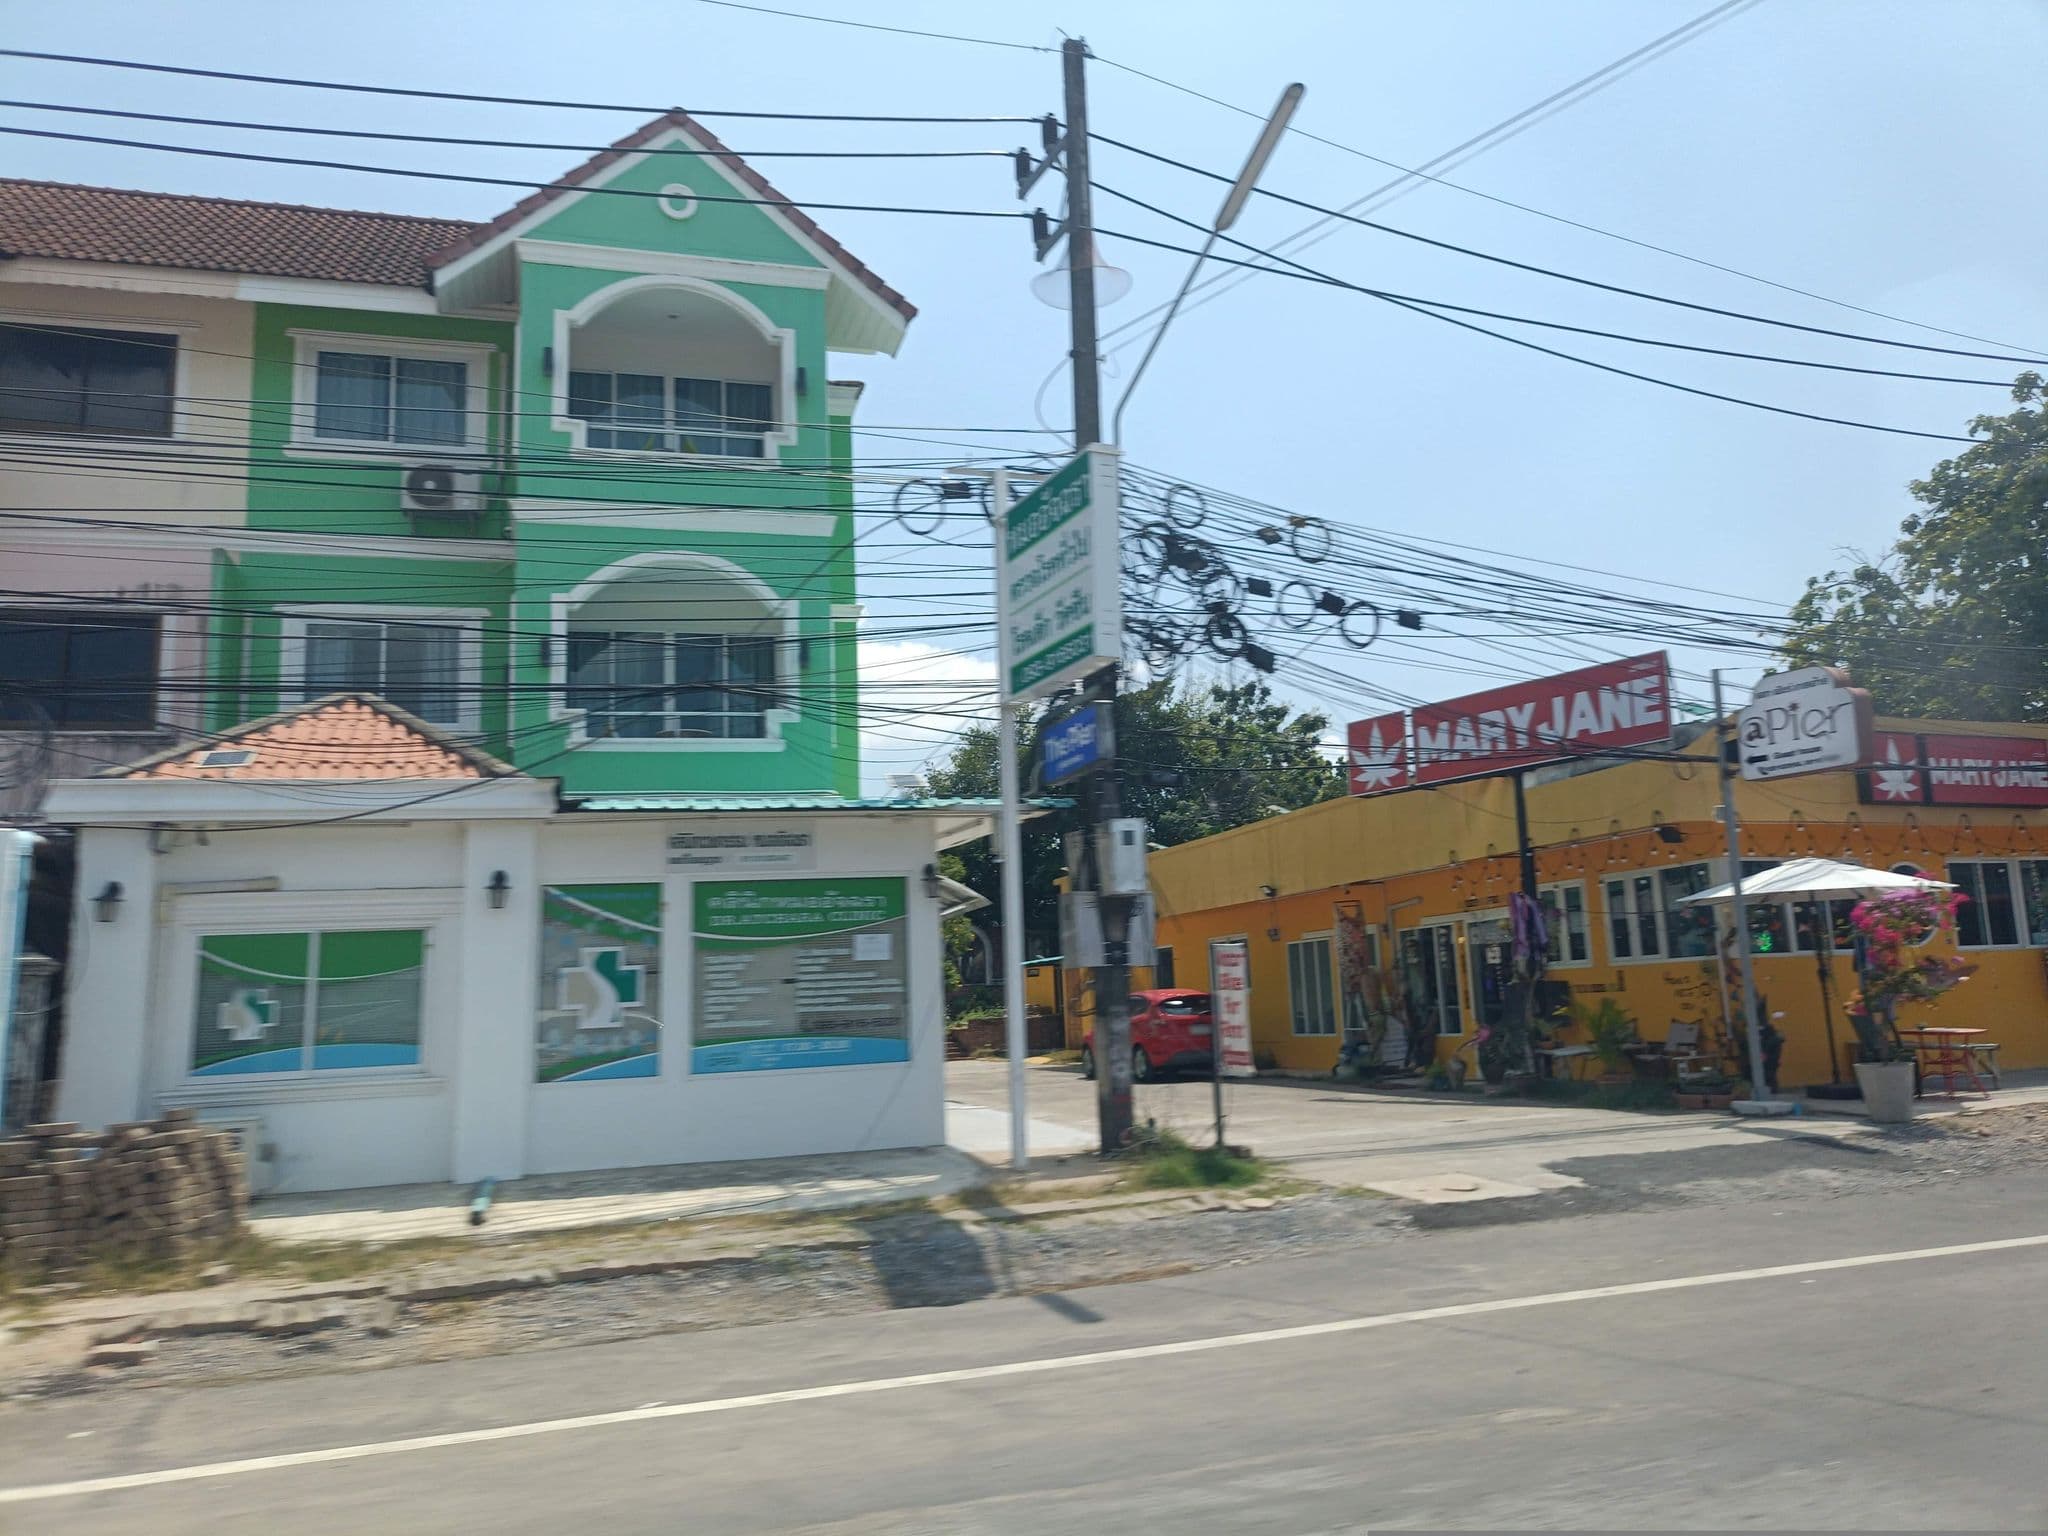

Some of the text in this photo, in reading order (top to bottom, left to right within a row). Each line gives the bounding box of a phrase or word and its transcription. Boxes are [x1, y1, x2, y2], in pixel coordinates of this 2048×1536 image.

[1417, 674, 1664, 768] MARY JANE
[1927, 757, 2048, 788] MARY JANE
